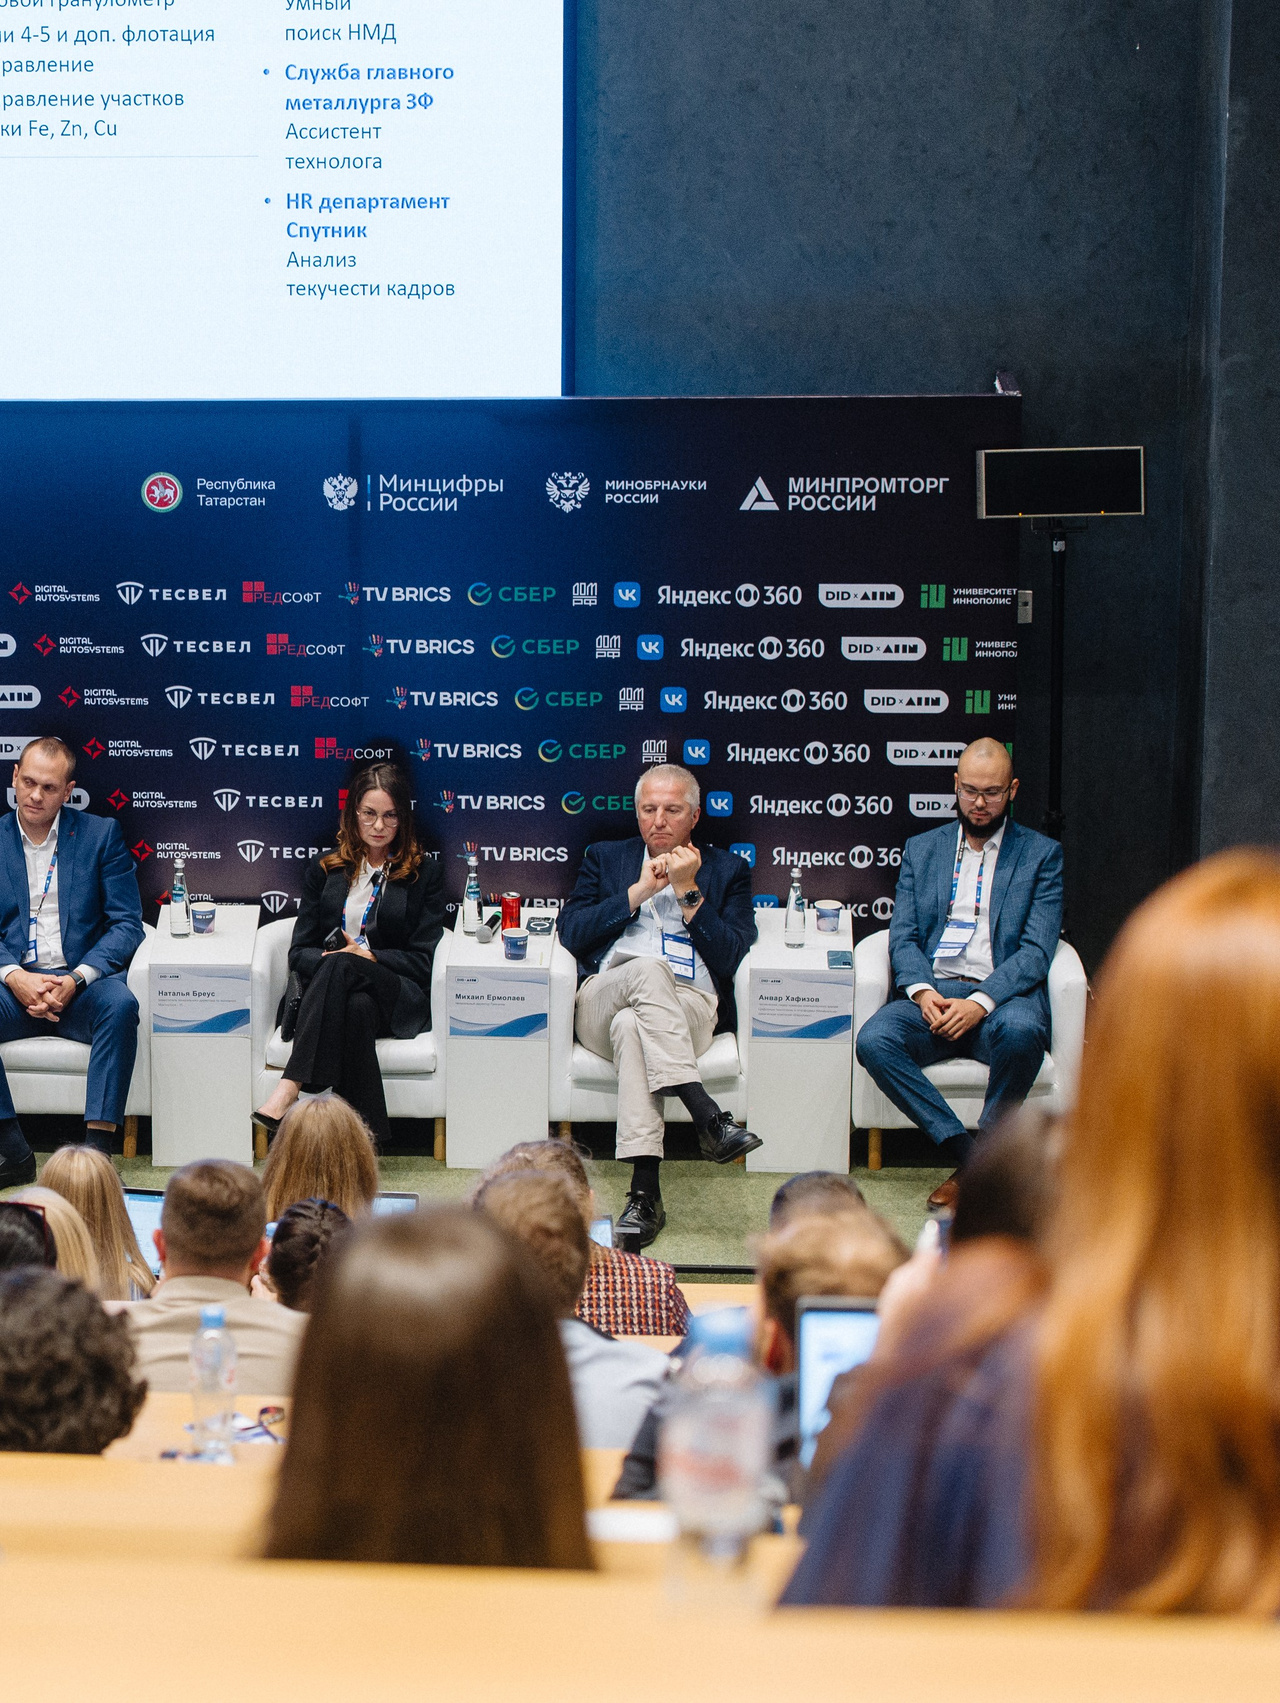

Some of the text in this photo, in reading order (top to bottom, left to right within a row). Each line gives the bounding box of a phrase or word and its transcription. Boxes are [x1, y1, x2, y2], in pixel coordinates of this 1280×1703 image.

[21, 26, 50, 42] 4-5
[58, 30, 67, 42] и
[74, 30, 115, 45] доп.
[122, 25, 214, 46] флотация
[286, 24, 396, 44] поиск НМД
[285, 63, 454, 84] Служба главного
[101, 94, 184, 110] участков
[286, 98, 400, 114] металлурга
[29, 120, 54, 139] Fe,
[61, 120, 87, 139] Zn,
[94, 120, 116, 136] Cu
[286, 123, 381, 139] Ассистент
[286, 157, 381, 169] технолога
[287, 193, 450, 213] HR департамент
[287, 222, 366, 242] Спутник
[287, 251, 356, 267] Анализ
[287, 284, 454, 300] текучести кадров
[197, 478, 275, 492] Республика
[380, 474, 503, 499] Минцифры
[606, 480, 706, 490] МИНОБРНАУКИ
[789, 477, 949, 493] МИНПРОМТОРГ
[197, 495, 265, 508] Татарстан
[380, 493, 457, 511] России
[605, 494, 658, 503] РОССИИ
[788, 495, 876, 511] РОССИИ
[35, 585, 68, 593] DIGITAL
[149, 589, 226, 600] ТЕСВЕЛ
[363, 587, 451, 602] TV BRICS
[499, 587, 556, 601] СБЕР
[658, 586, 802, 607] Яндекс 360
[173, 641, 250, 652] ТЕСВЕЛ
[386, 639, 474, 654] TV BRICS
[681, 638, 824, 659] Яндекс 360
[434, 744, 521, 758] TV BRICS
[727, 743, 870, 764] Яндекс 360
[246, 796, 322, 807] ТЕСВЕЛ
[481, 847, 568, 862] TV BRICS
